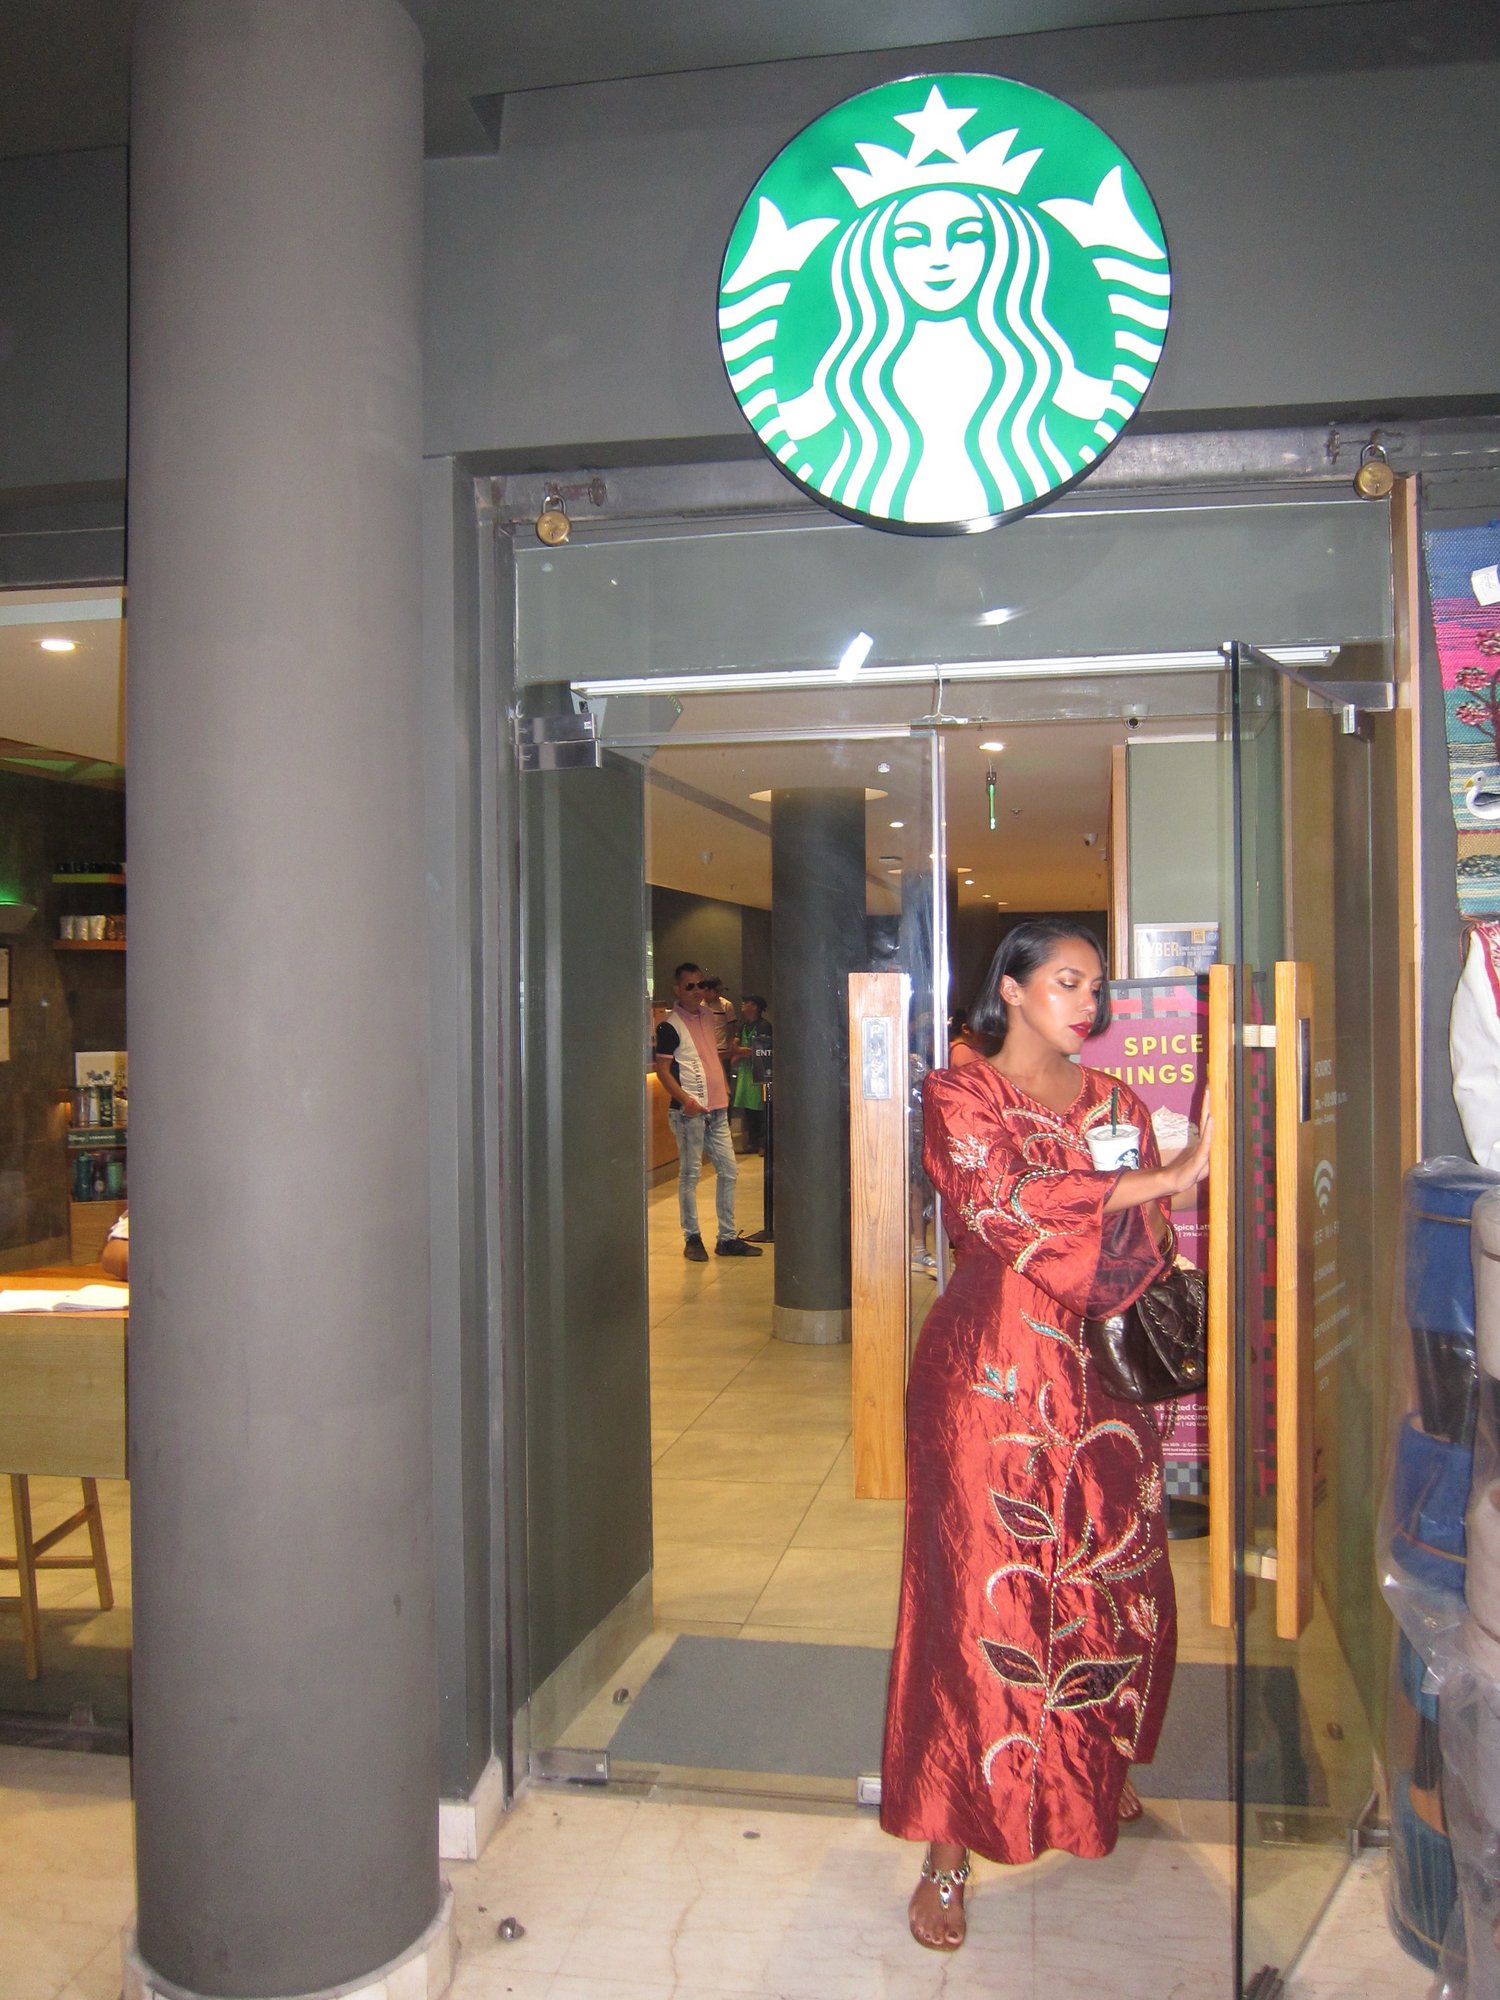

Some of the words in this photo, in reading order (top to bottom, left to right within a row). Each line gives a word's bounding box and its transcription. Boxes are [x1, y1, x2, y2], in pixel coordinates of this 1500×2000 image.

[1124, 1034, 1204, 1057] SPICE
[1173, 1223, 1195, 1232] Spice
[1160, 1413, 1208, 1421] Frapuccino
